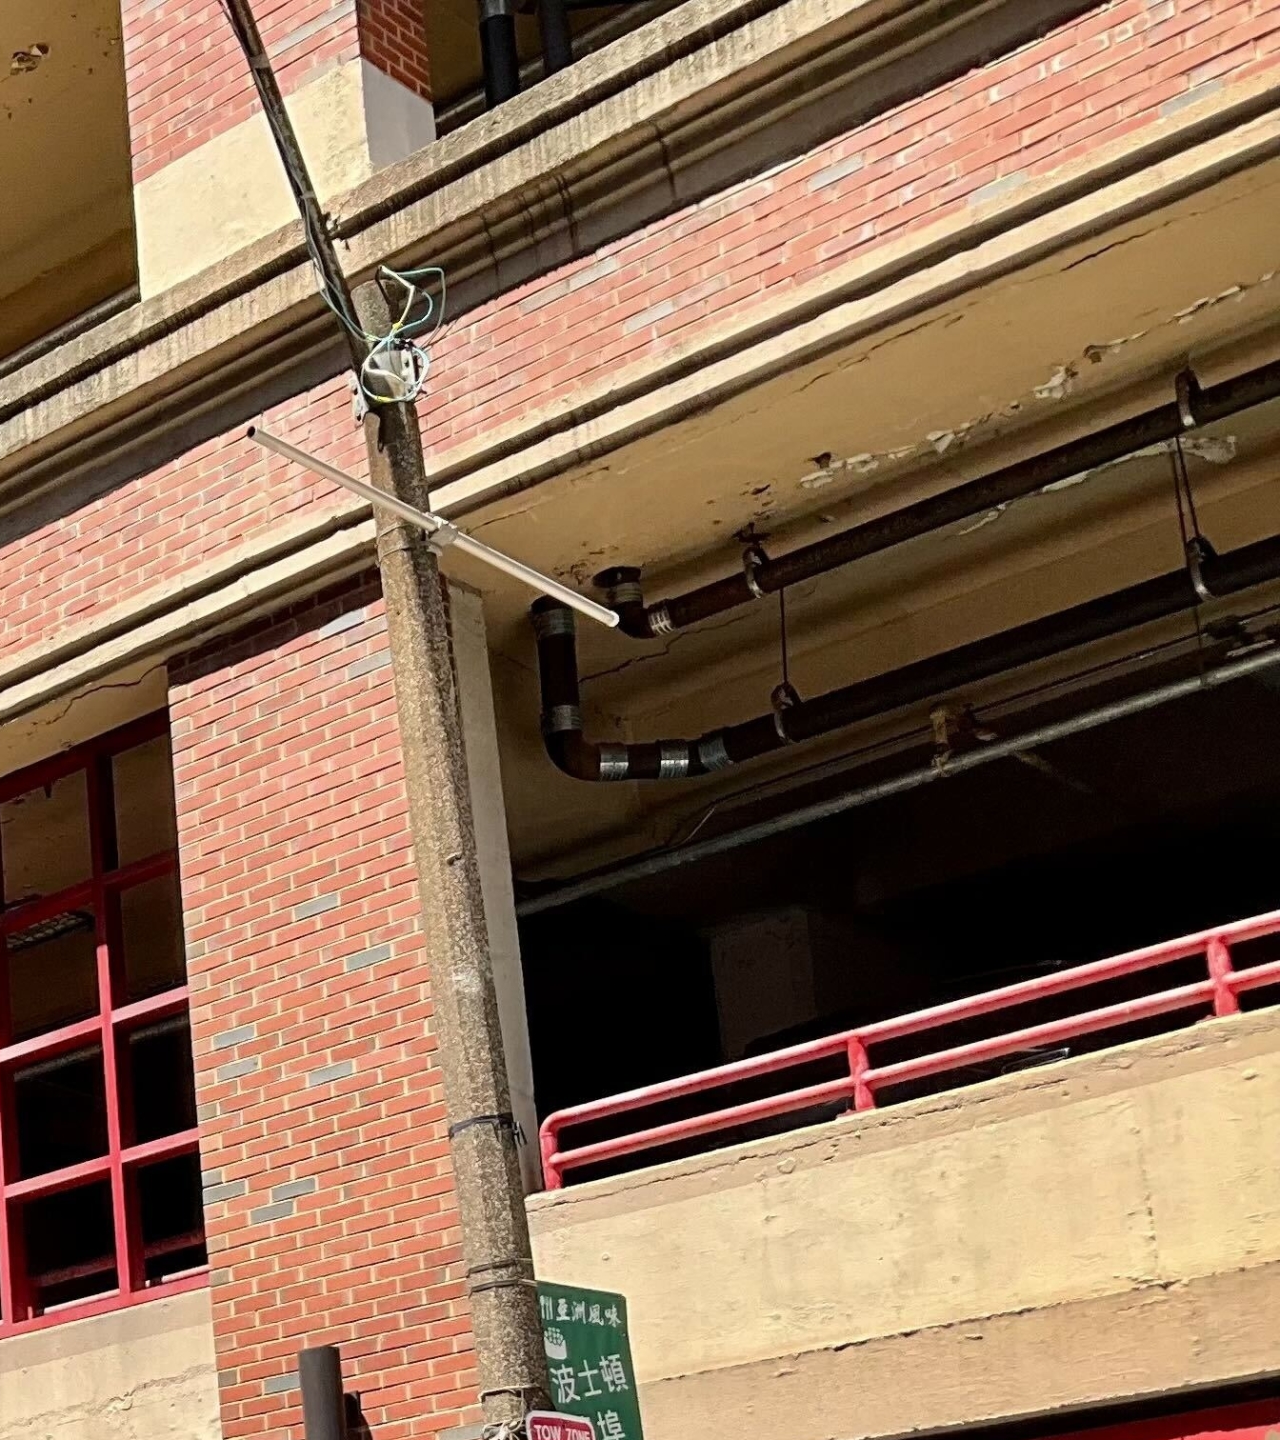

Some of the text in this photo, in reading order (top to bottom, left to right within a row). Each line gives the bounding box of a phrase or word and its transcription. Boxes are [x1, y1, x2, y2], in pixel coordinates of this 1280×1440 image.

[555, 1298, 622, 1328] 亞洲風味
[549, 1353, 629, 1404] 波士頓
